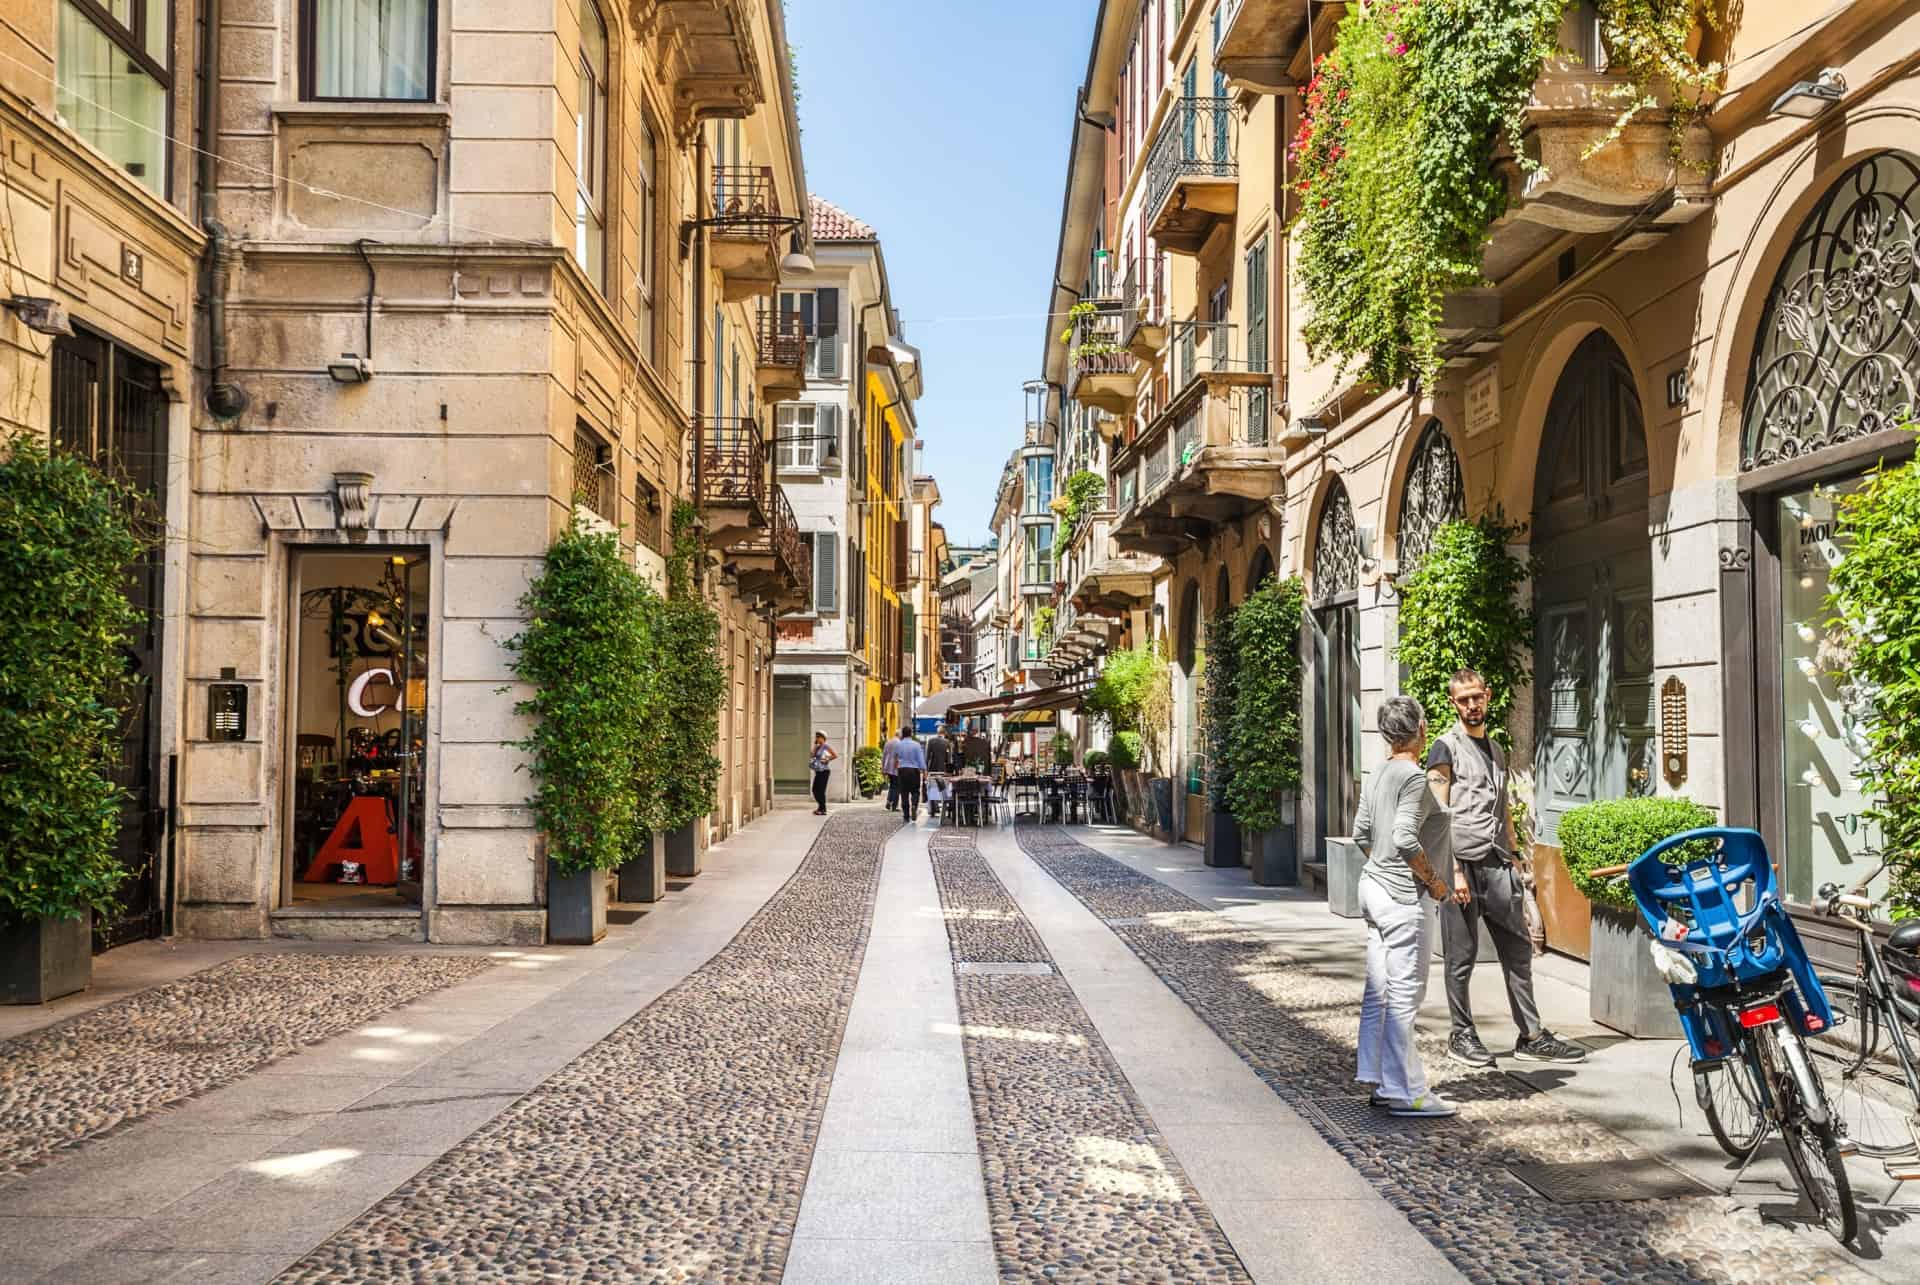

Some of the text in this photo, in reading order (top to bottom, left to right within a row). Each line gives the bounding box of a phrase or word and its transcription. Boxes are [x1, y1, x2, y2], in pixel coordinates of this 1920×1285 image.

[128, 254, 137, 277] 3
[1671, 374, 1687, 402] 16
[348, 668, 402, 717] C
[304, 796, 398, 885] A
